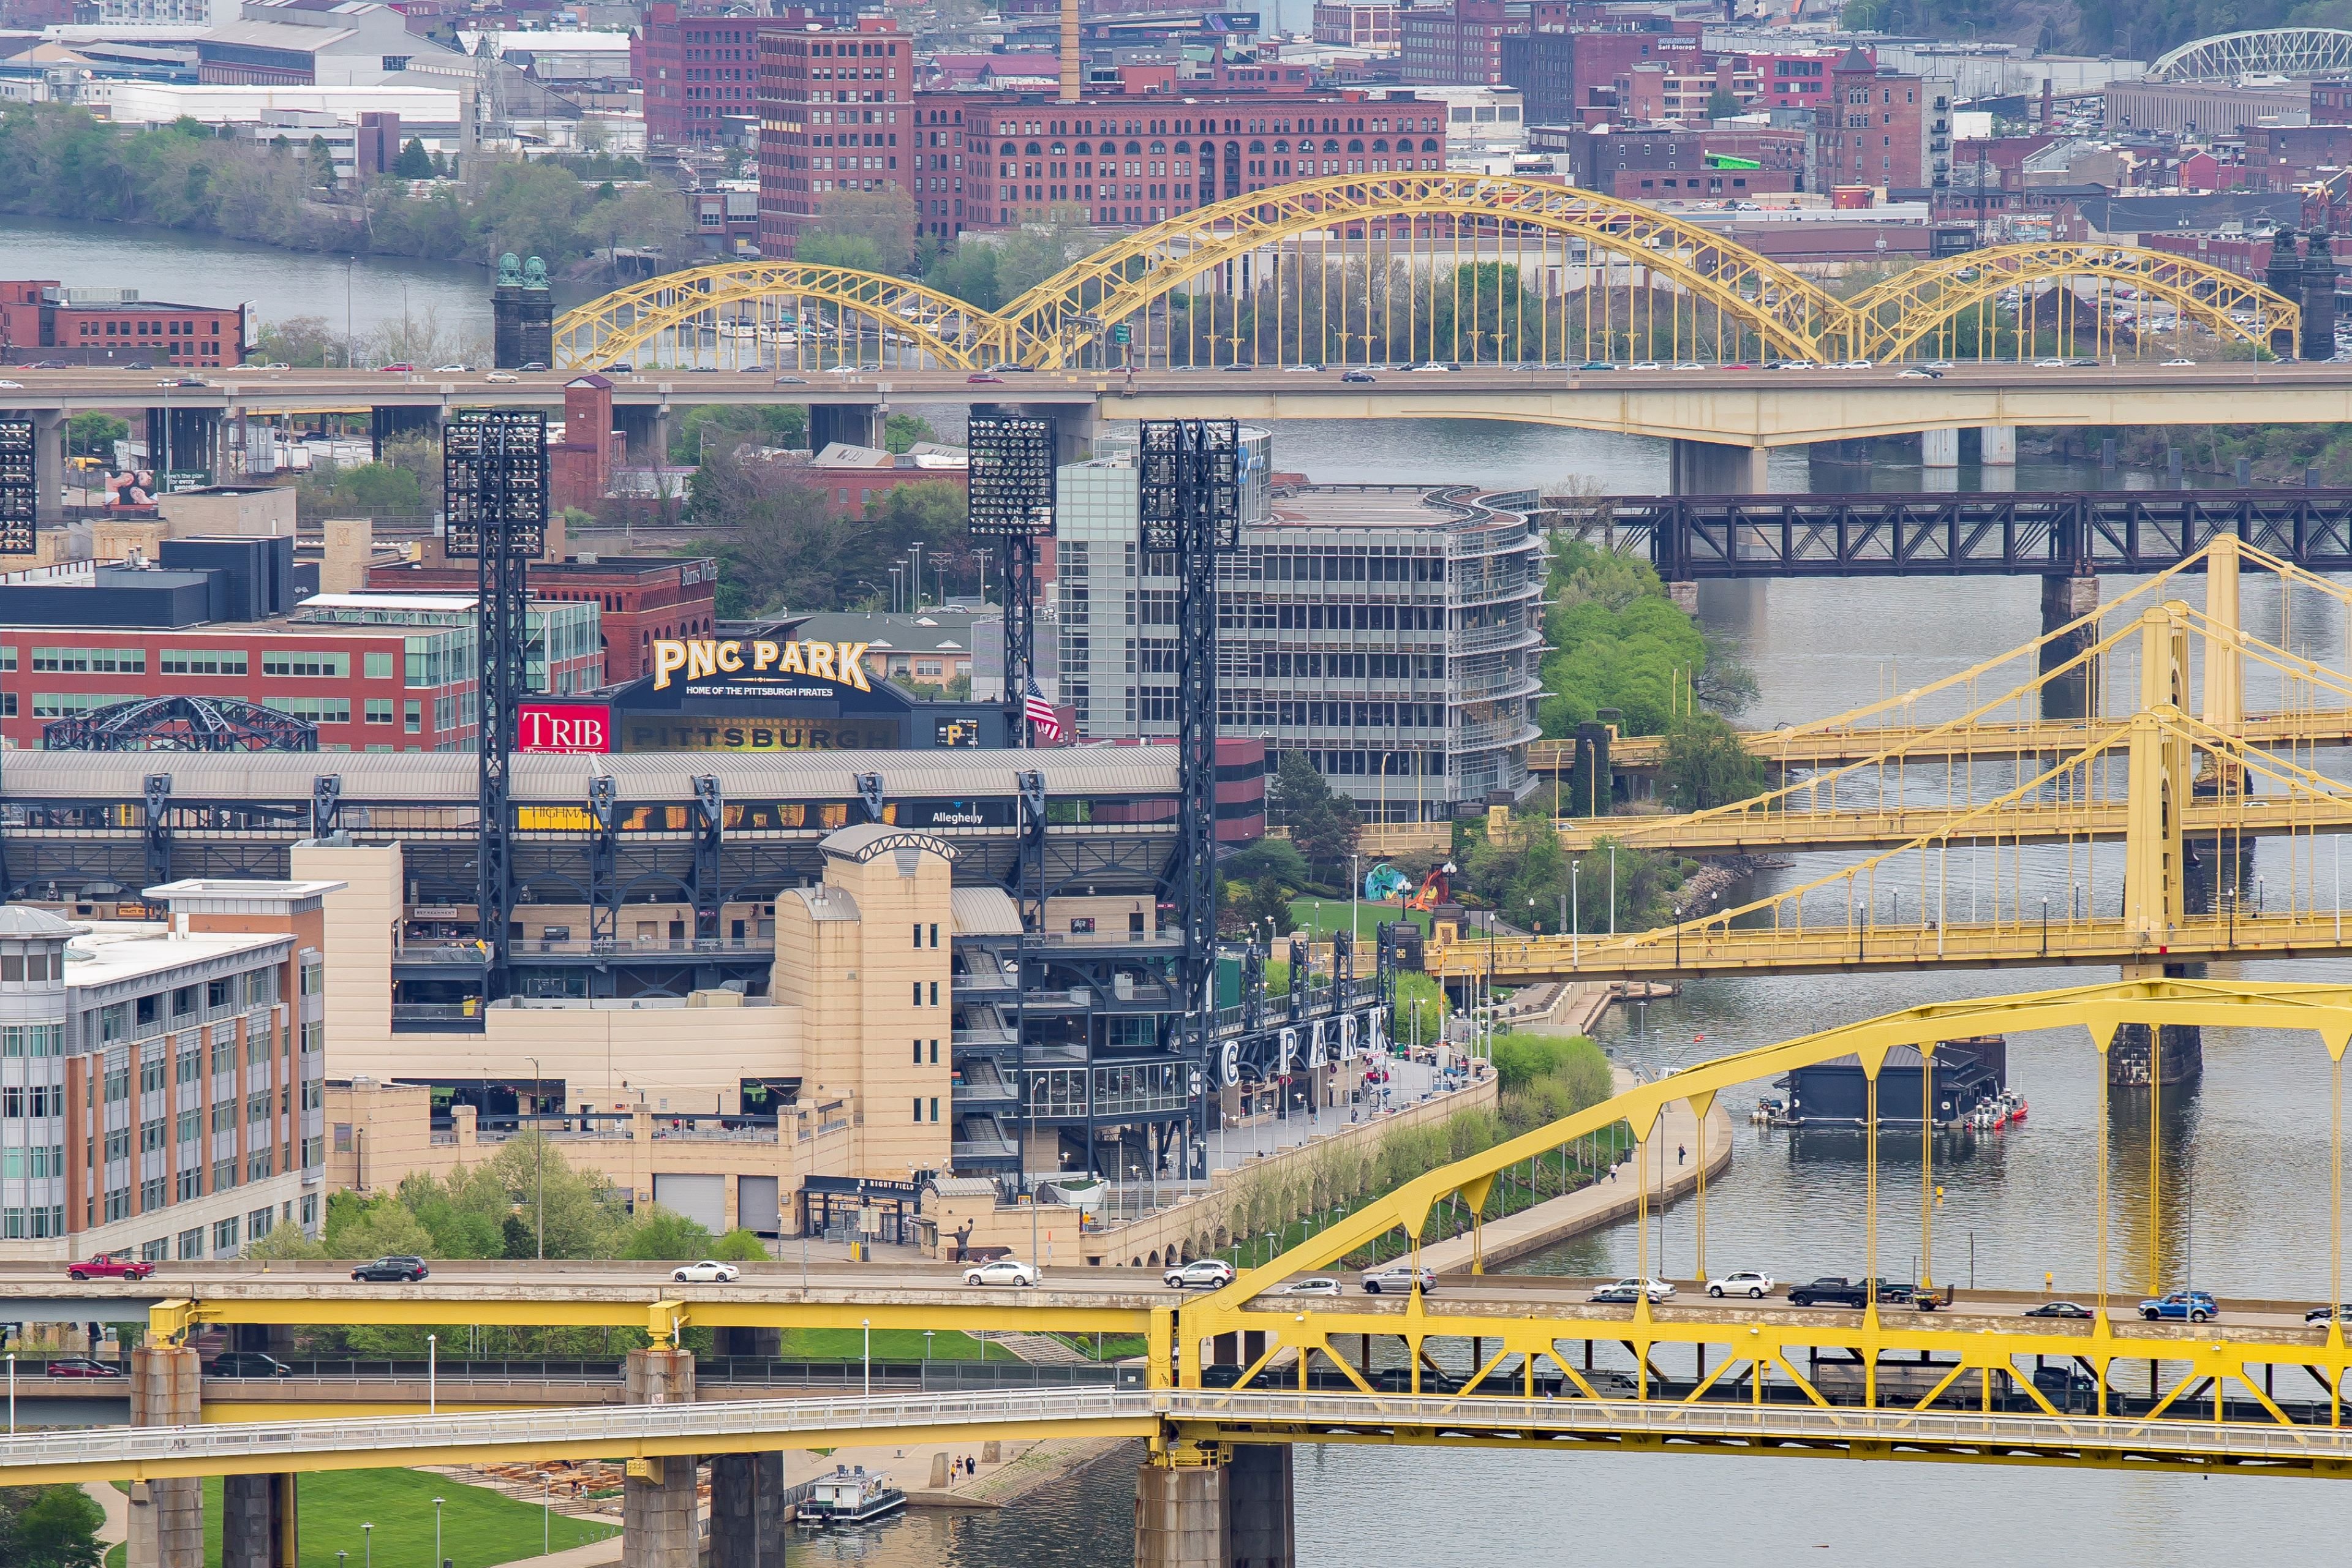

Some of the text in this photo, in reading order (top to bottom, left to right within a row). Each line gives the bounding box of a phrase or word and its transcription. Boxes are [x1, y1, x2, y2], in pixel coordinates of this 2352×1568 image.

[682, 560, 718, 586] Burns White
[653, 639, 871, 693] PNC PARK
[686, 686, 834, 697] HOME OF THE PITTSBURGH PIRATES
[522, 712, 603, 747] TRIB
[630, 725, 892, 750] PITTSBURGH
[932, 812, 983, 824] Allegheny
[870, 1180, 893, 1188] RIGHT
